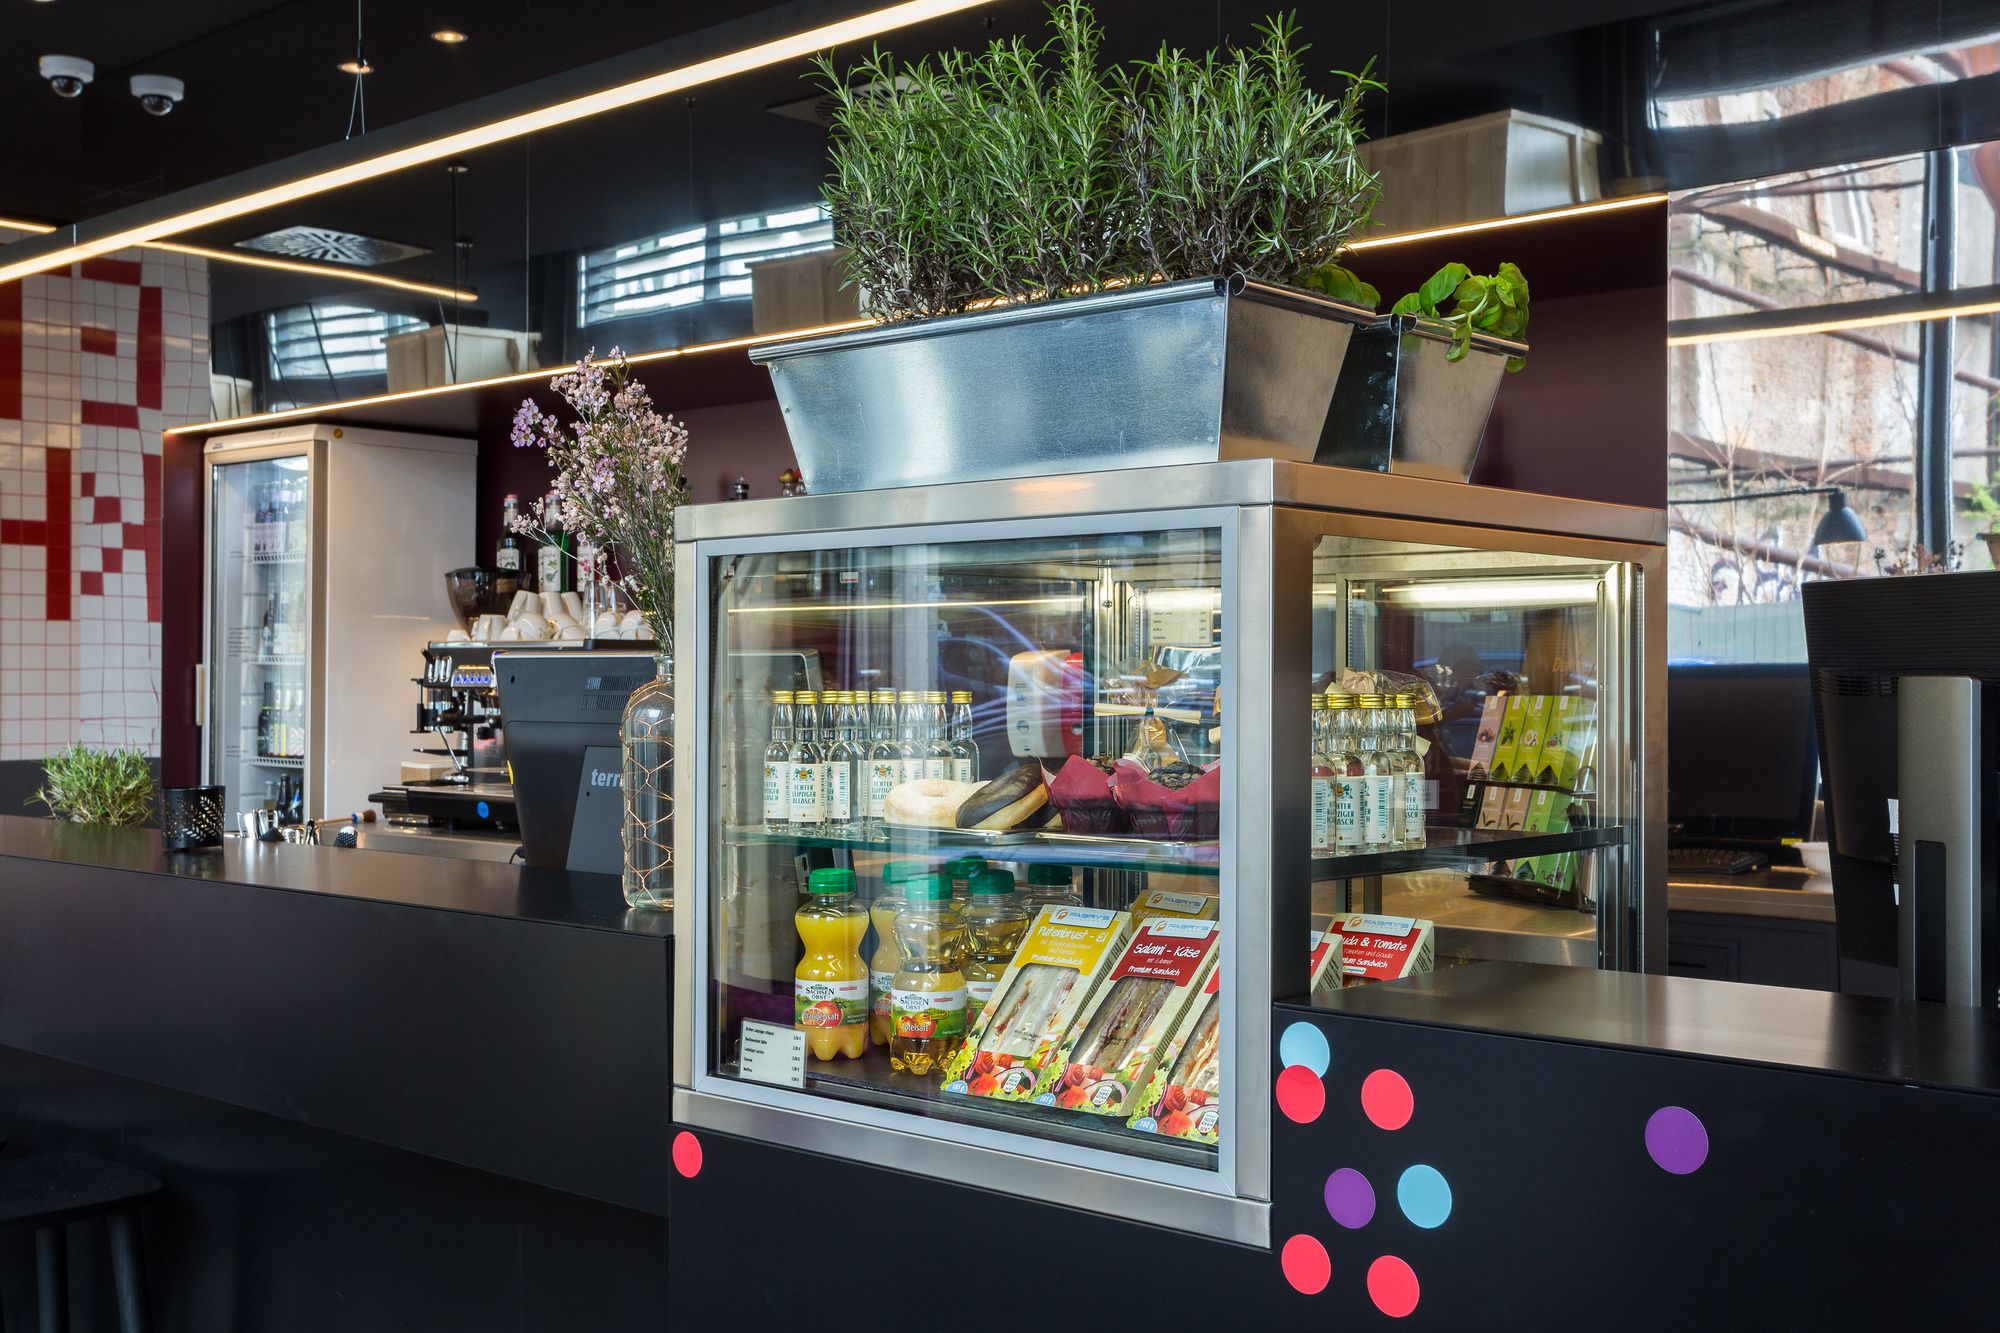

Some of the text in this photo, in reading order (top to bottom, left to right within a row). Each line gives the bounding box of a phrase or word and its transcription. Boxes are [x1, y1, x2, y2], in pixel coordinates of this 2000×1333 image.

[1037, 925, 1089, 941] Putenbrust
[1133, 942, 1168, 956] Salami
[1173, 945, 1201, 958] Käse
[1360, 937, 1370, 947] &
[1373, 939, 1408, 952] Tomate
[1356, 958, 1388, 969] Sandwich
[805, 987, 835, 996] SACHSEN
[900, 997, 929, 1006] SACHSEN
